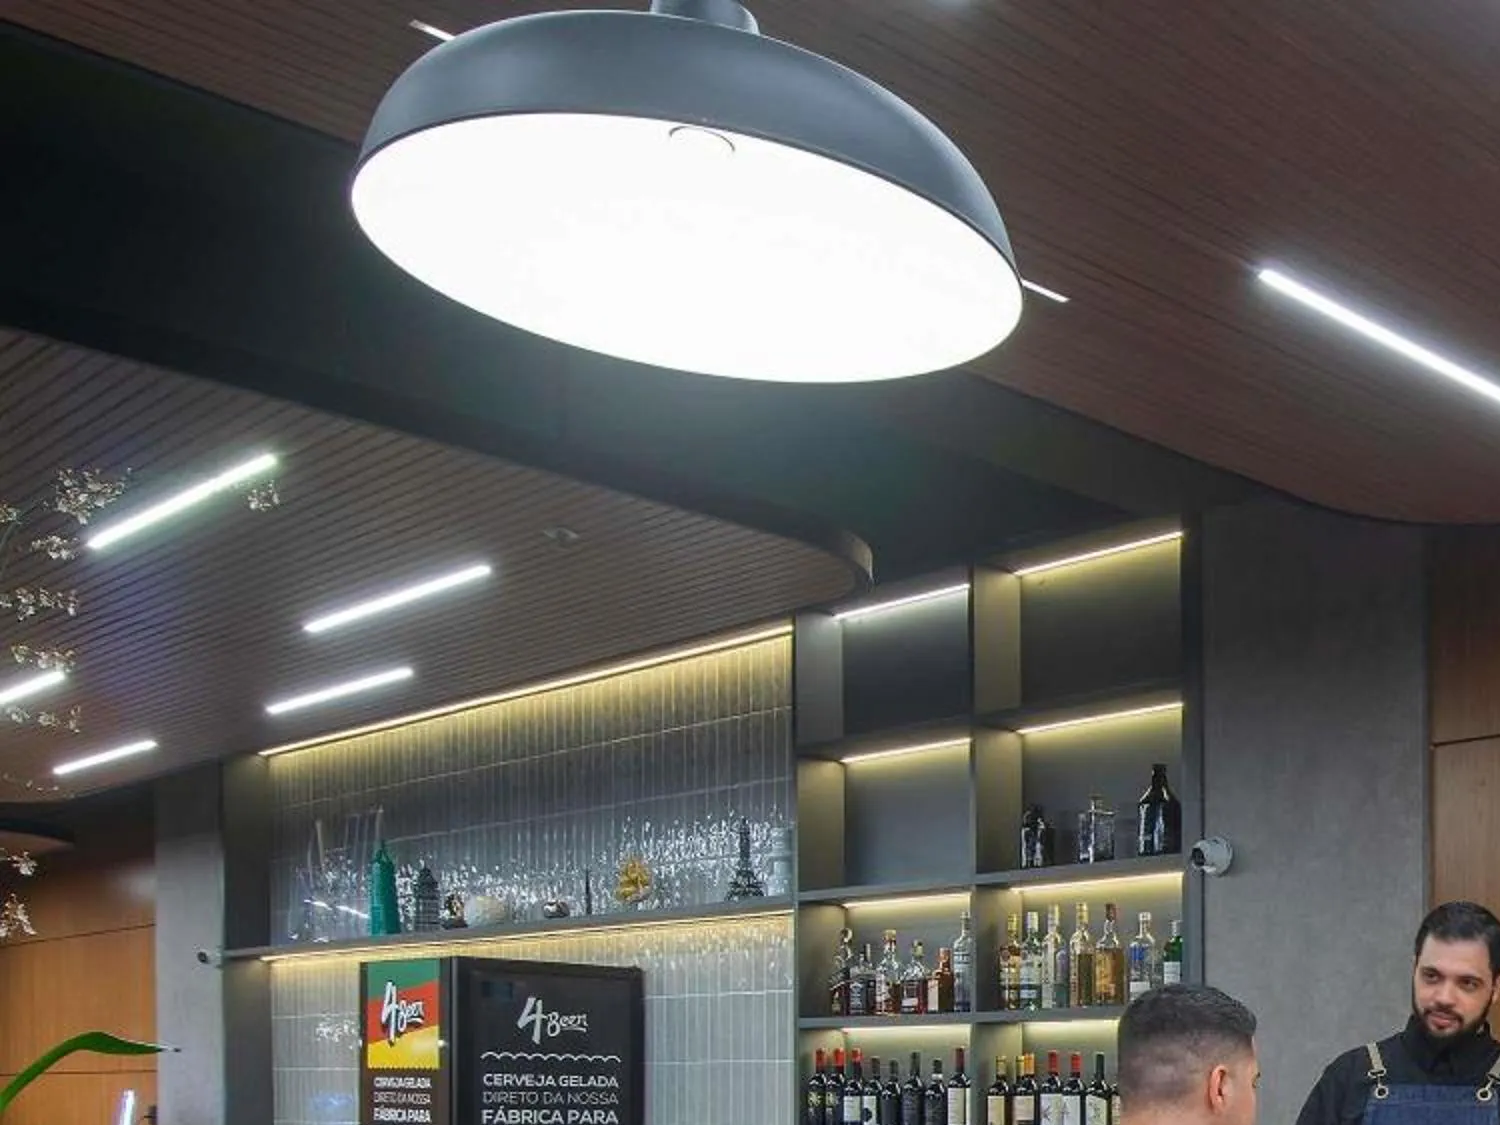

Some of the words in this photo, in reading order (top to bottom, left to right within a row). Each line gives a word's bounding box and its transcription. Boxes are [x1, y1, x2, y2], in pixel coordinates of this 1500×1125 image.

[517, 997, 547, 1044] 4
[483, 1073, 557, 1087] CERVEJA
[559, 1075, 619, 1088] GELADA
[483, 1091, 539, 1104] DIRETO
[543, 1091, 565, 1104] DA
[567, 1091, 619, 1105] NOSSA
[482, 1105, 565, 1124] FÁBRICA
[567, 1110, 619, 1124] PARA
